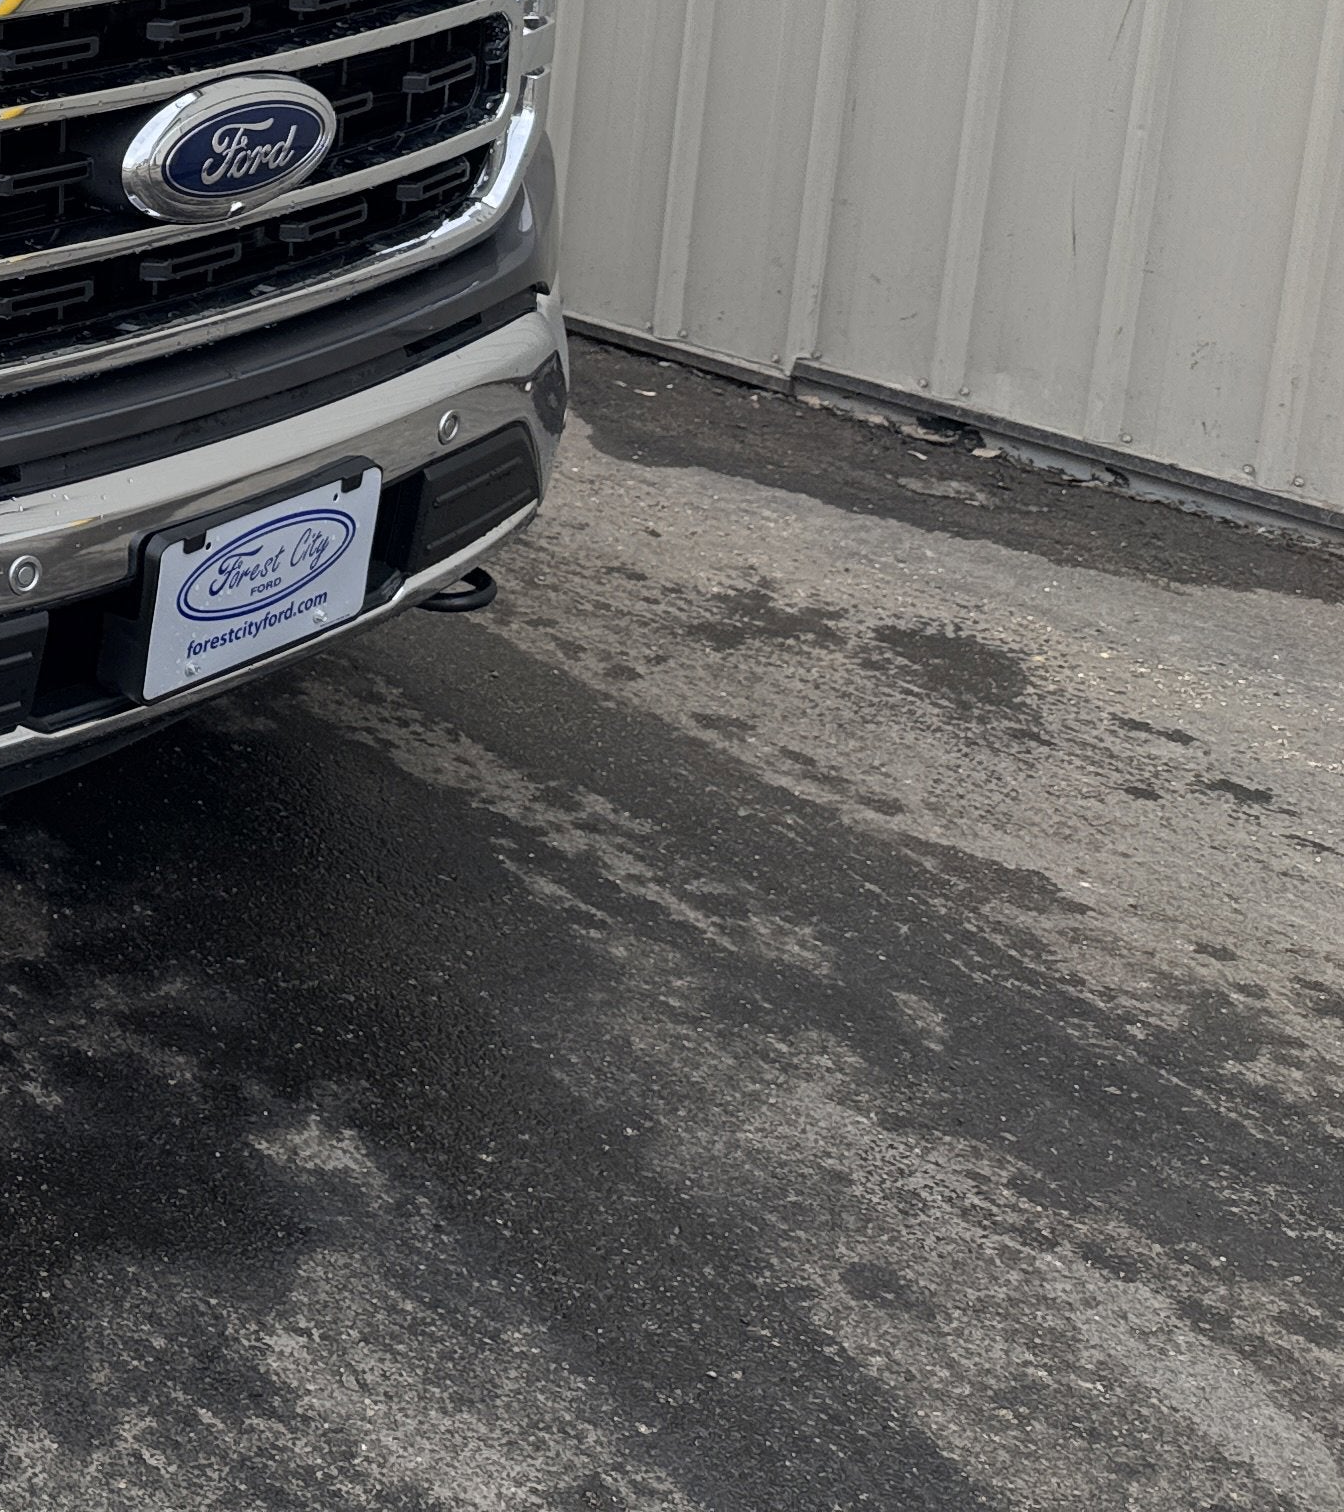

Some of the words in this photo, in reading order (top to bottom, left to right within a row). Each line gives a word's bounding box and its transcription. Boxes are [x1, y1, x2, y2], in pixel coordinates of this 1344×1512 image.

[200, 117, 297, 186] Ford
[208, 543, 285, 597] Forest
[289, 527, 330, 572] City
[249, 576, 282, 597] FORD
[186, 590, 329, 659] forestcityford.com
